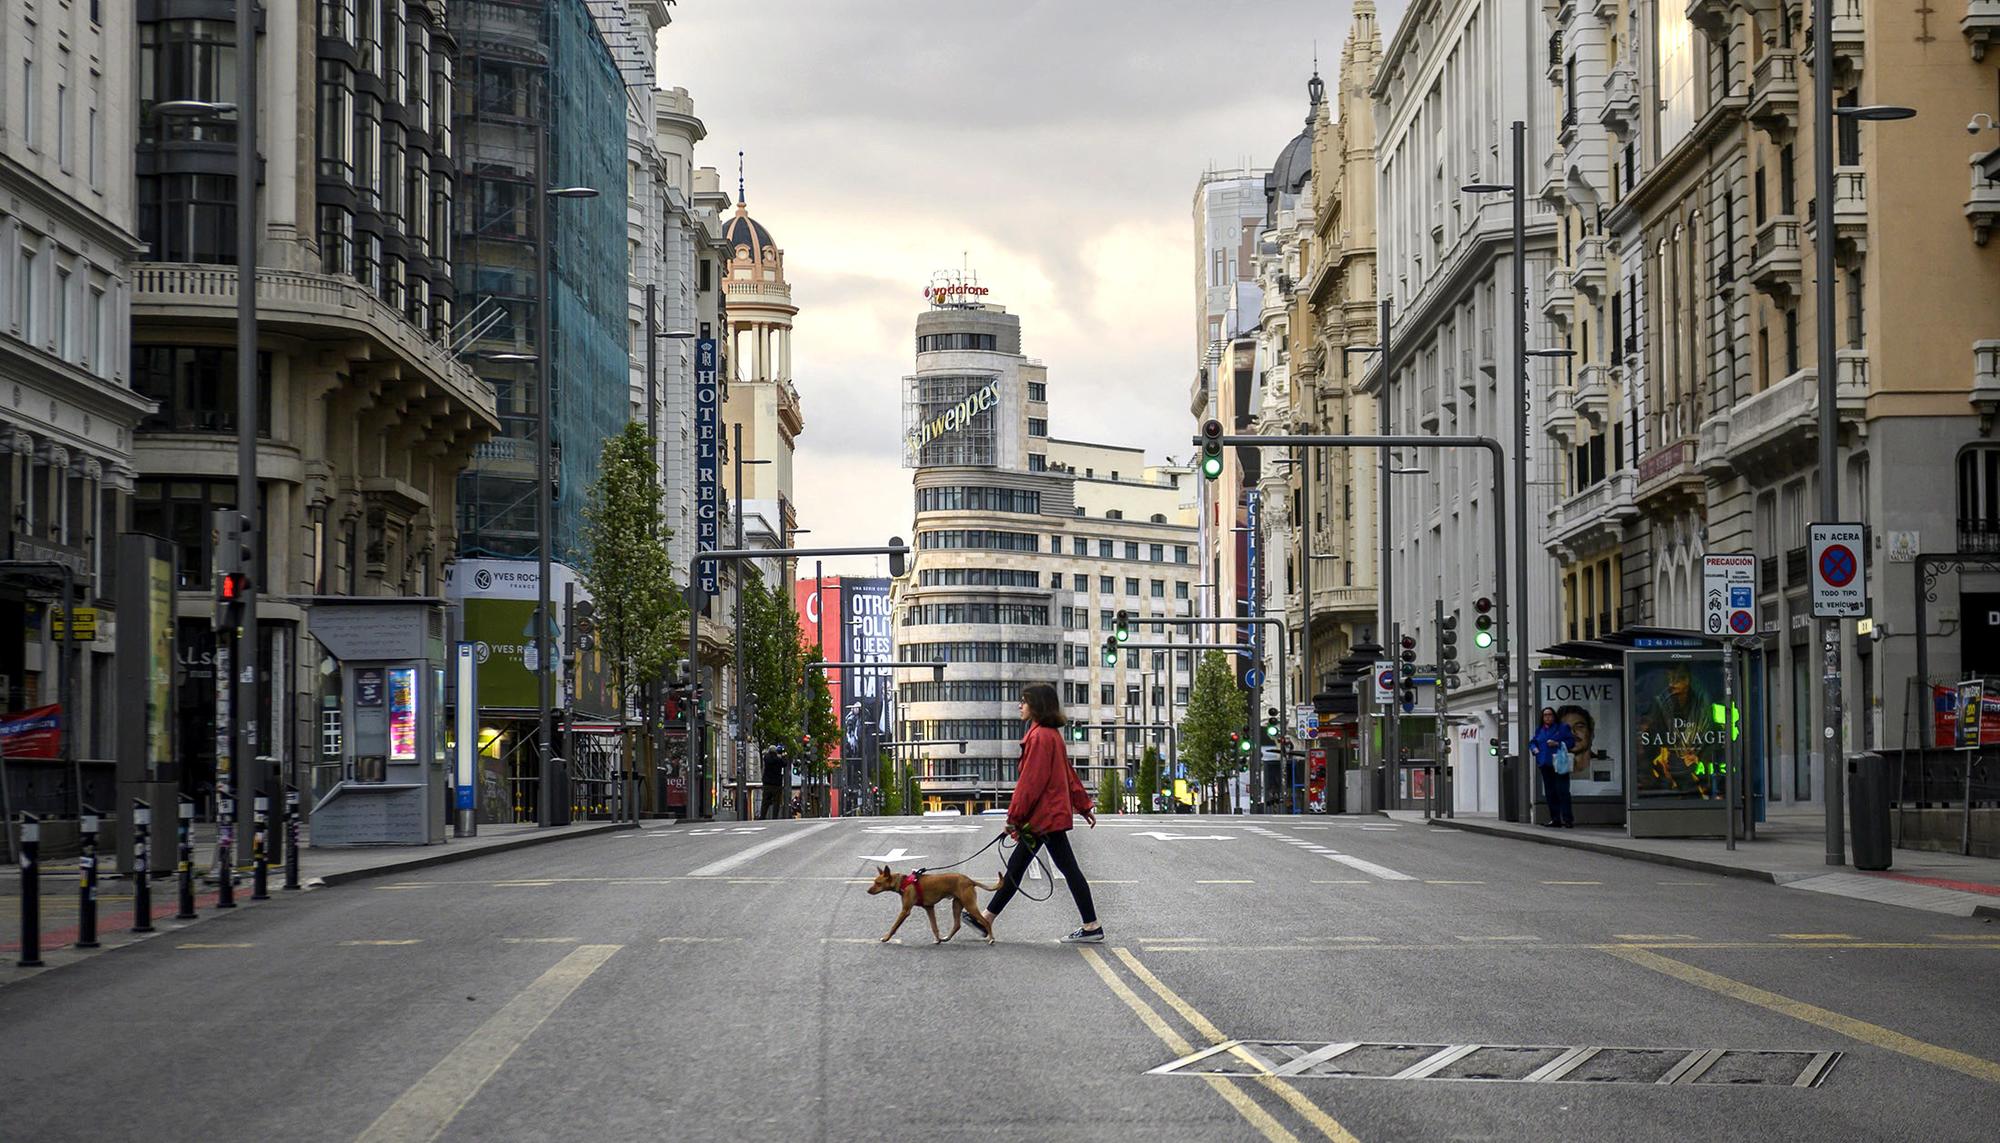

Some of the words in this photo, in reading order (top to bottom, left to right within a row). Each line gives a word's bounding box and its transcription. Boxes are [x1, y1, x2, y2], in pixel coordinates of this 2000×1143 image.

[933, 283, 988, 296] vodafone
[698, 369, 716, 458] HOTEL
[906, 378, 1001, 458] Schweppes
[699, 467, 716, 593] REGENTE
[1814, 533, 1826, 541] EN
[1831, 533, 1860, 541] ACERA
[1706, 557, 1753, 566] PRECAUCIÓN
[493, 572, 515, 581] YVES
[516, 573, 540, 582] ROCH
[1827, 601, 1864, 609] VEHÍCUS
[491, 645, 514, 654] YVES
[1546, 685, 1613, 701] LOEWE
[1674, 718, 1695, 729] Dior
[1641, 730, 1725, 746] SAUVAGE
